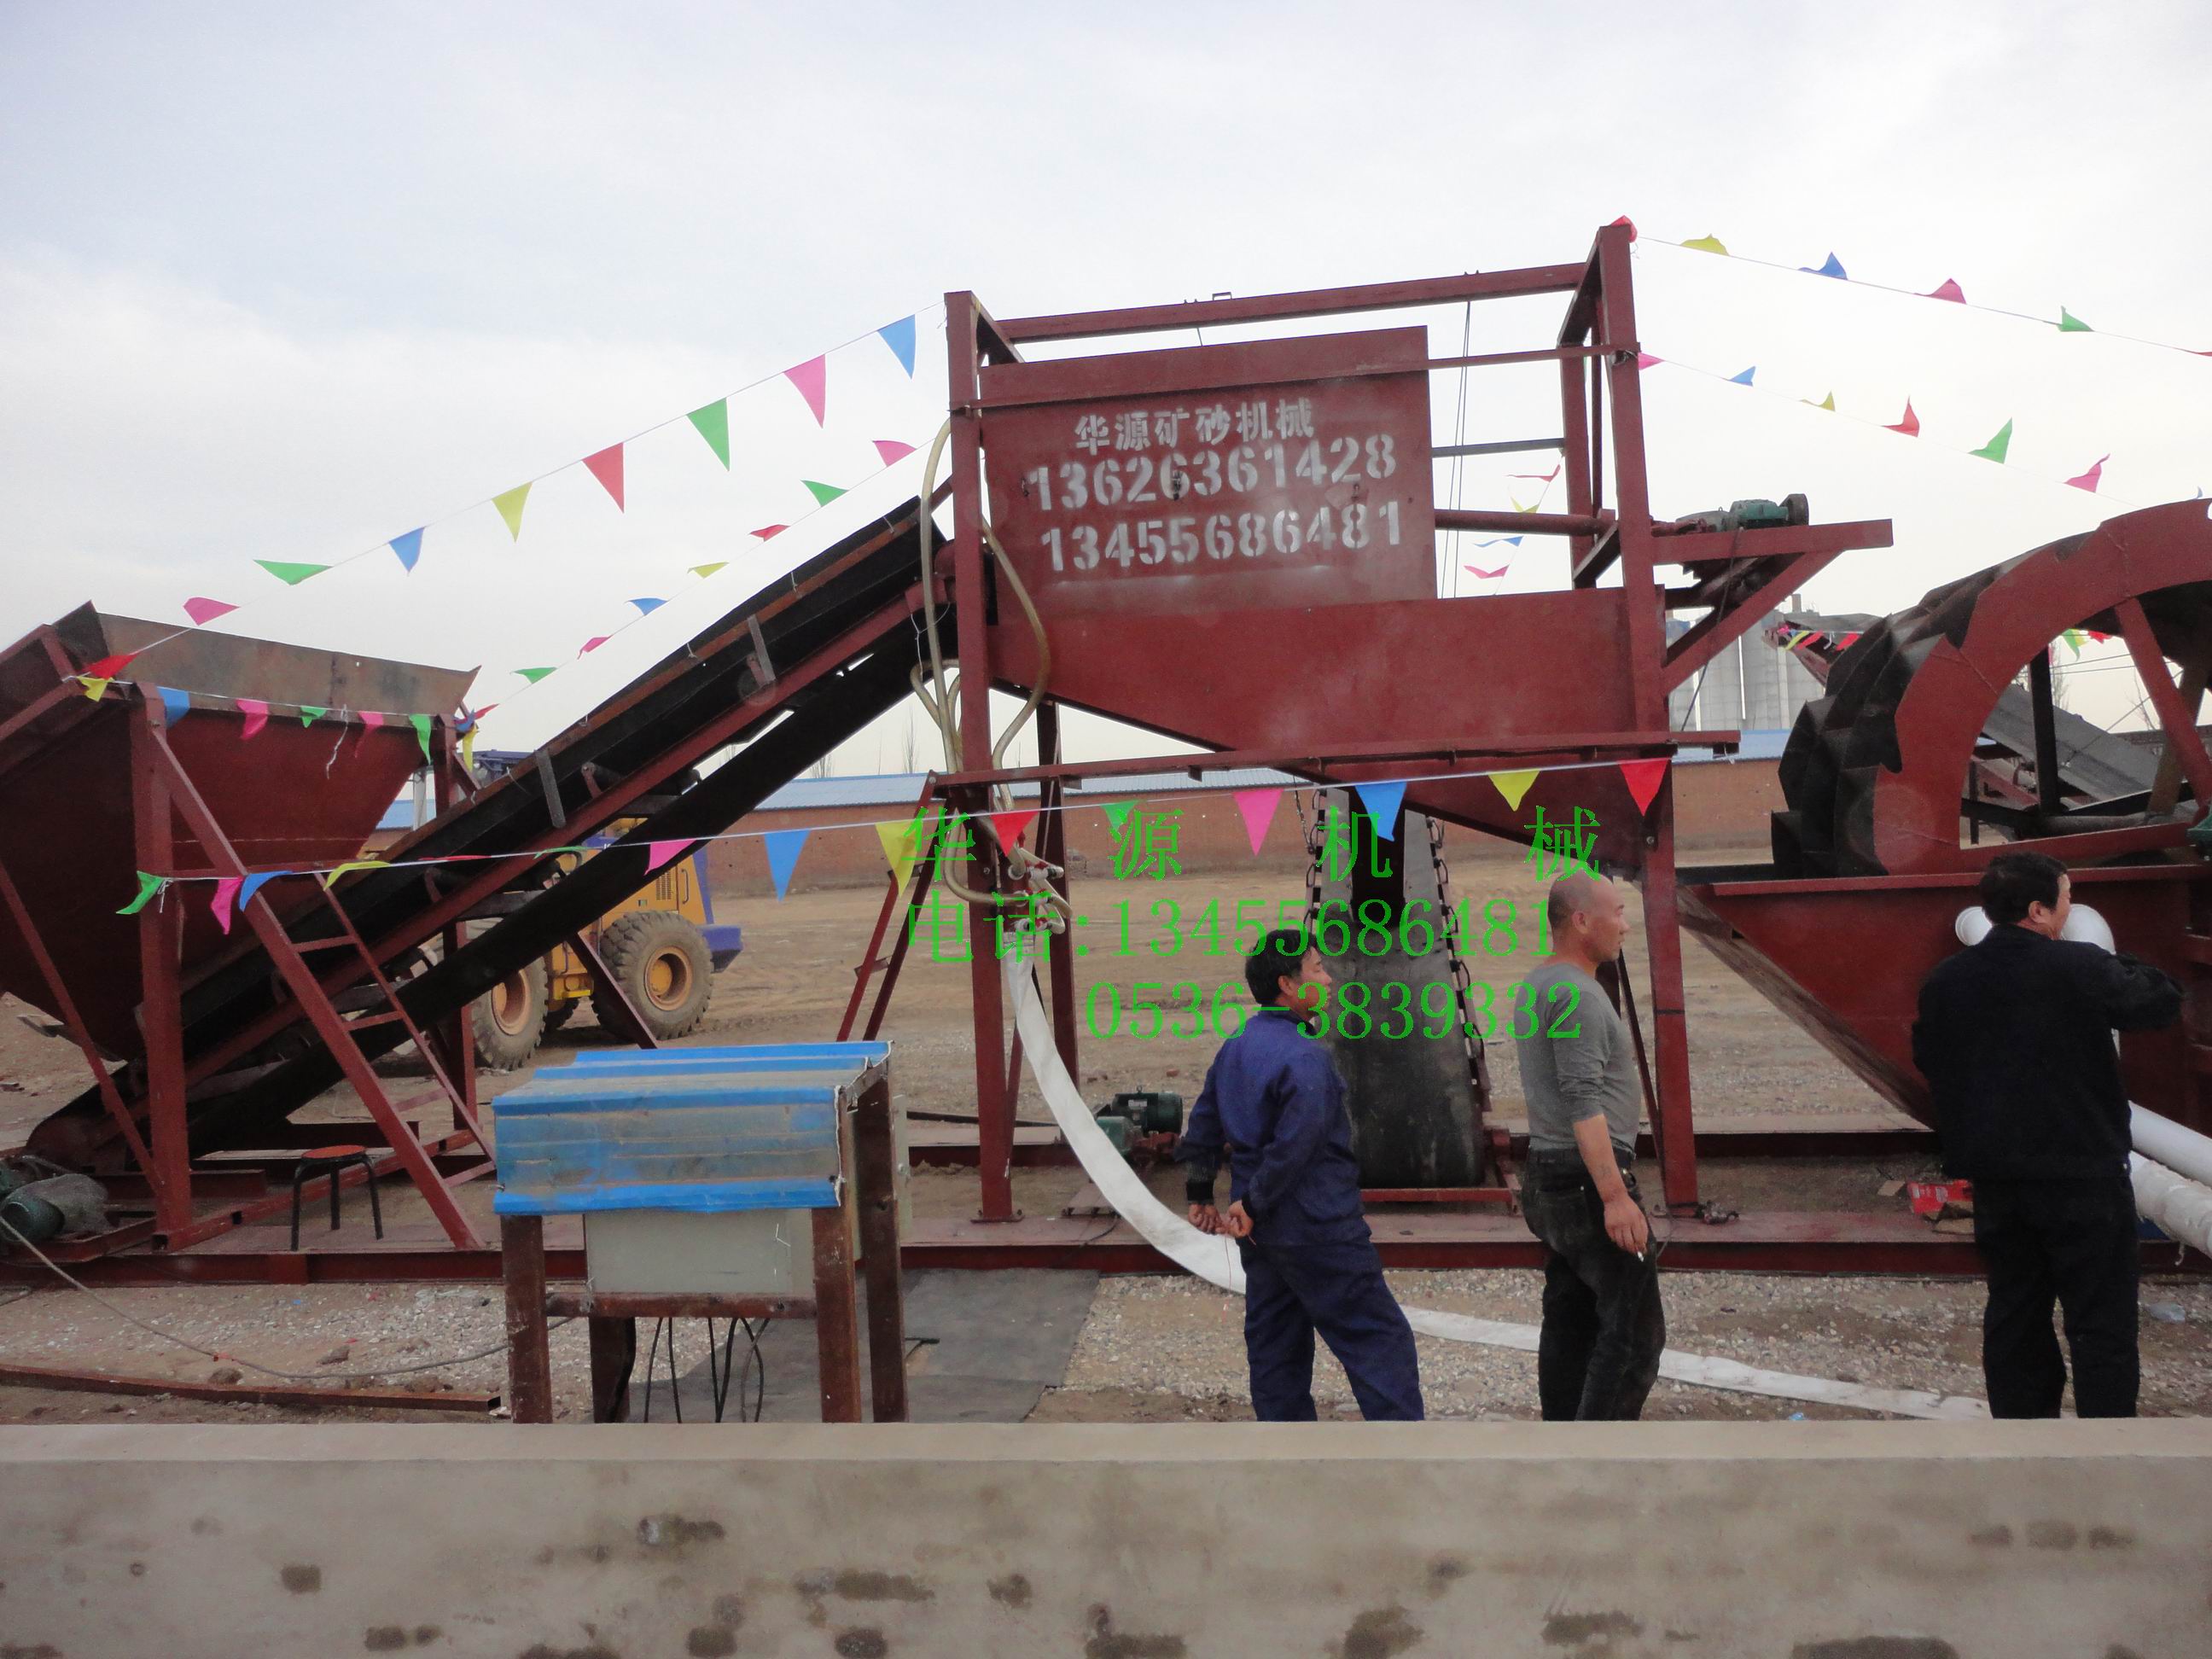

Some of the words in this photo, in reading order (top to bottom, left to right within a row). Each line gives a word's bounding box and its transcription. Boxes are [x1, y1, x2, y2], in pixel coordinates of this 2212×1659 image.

[1074, 398, 1315, 456] 华源矿砂机械
[1027, 433, 1398, 511] 13626361428
[1041, 501, 1400, 572] 13455686481
